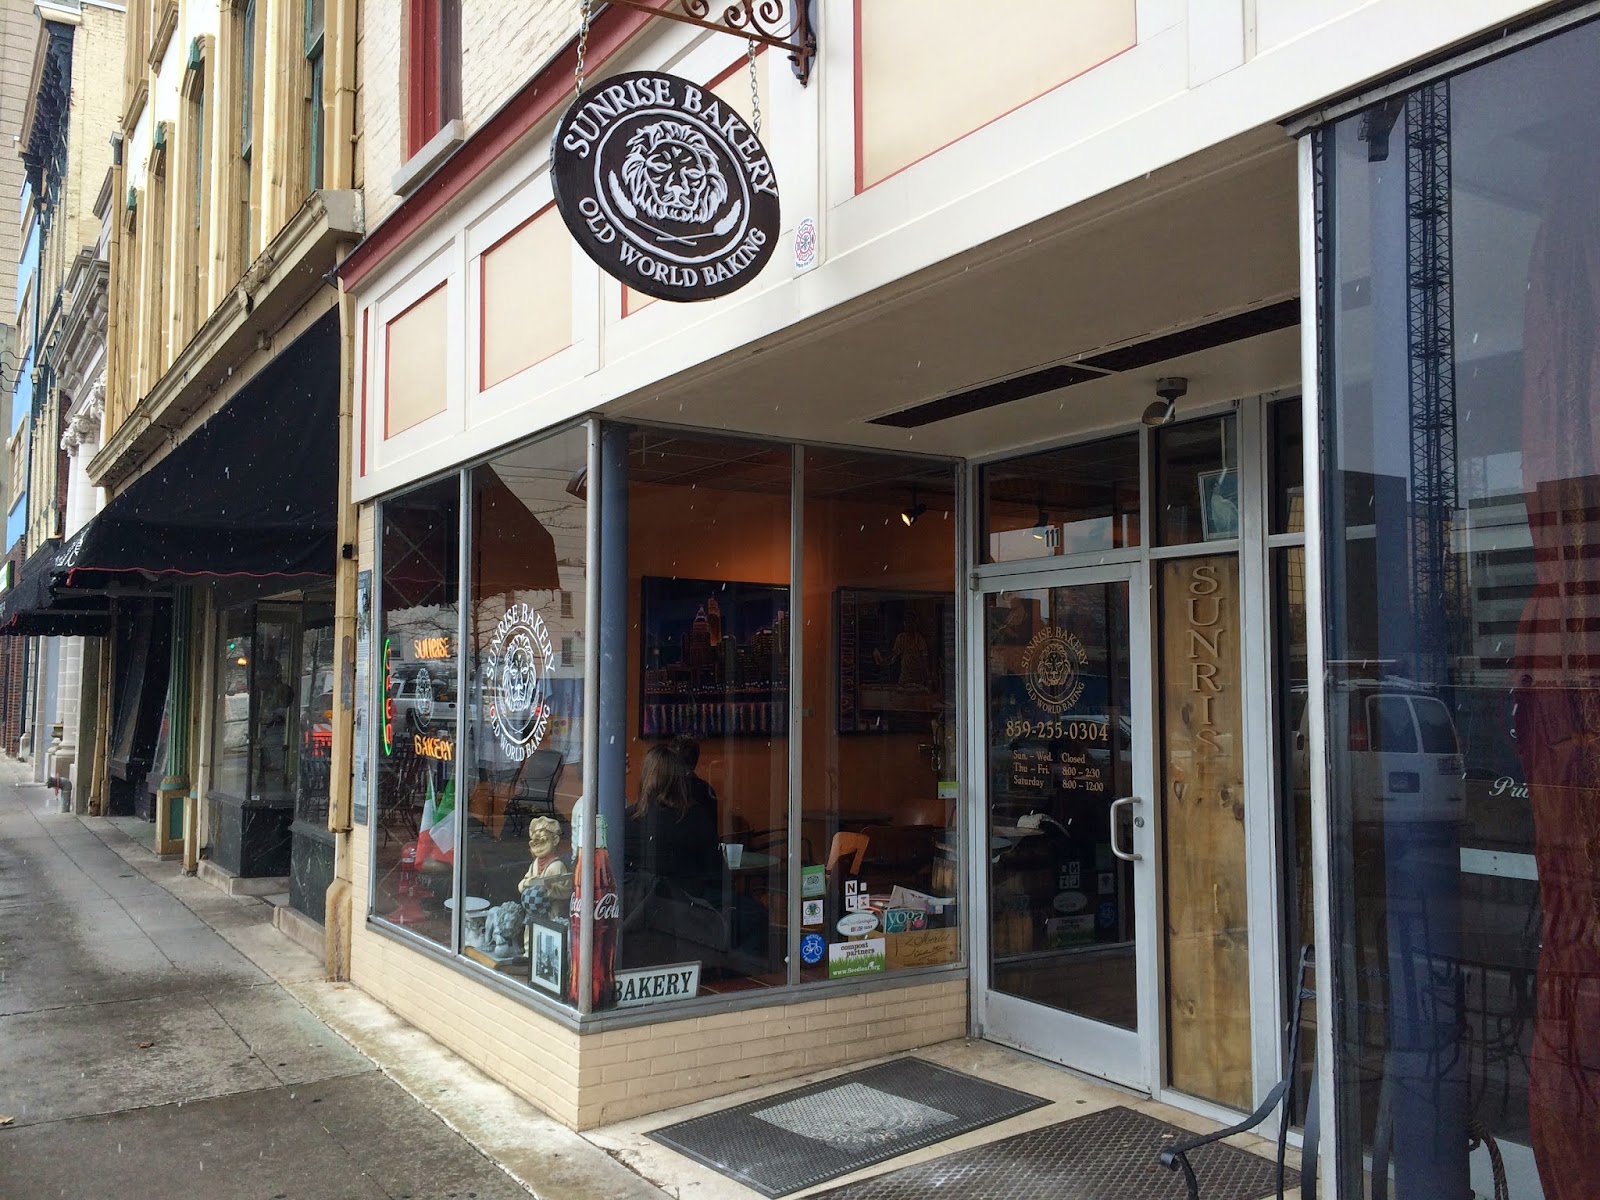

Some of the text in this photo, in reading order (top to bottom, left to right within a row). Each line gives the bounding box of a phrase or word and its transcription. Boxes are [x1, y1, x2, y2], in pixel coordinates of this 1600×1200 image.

[563, 77, 780, 199] SUNRISE BAKERY
[579, 197, 767, 288] OLD WORLD BAKING
[1044, 528, 1060, 548] 111
[486, 602, 556, 681] SUNRISE BAKERY
[1021, 626, 1089, 669] SUNRISE BAKERY
[1186, 566, 1224, 779] SUNRIS
[1025, 682, 1085, 714] OLD WORLD BAKING
[489, 704, 551, 763] OLD WORLD BAKING
[1006, 720, 1108, 741] 859-255-0304
[1013, 750, 1028, 760] Sun.
[1061, 752, 1086, 764] Closed
[1013, 762, 1028, 773] Thu
[1013, 774, 1045, 788] Saturday
[887, 911, 924, 931] yoga
[841, 941, 869, 951] compost
[846, 948, 875, 958] partners
